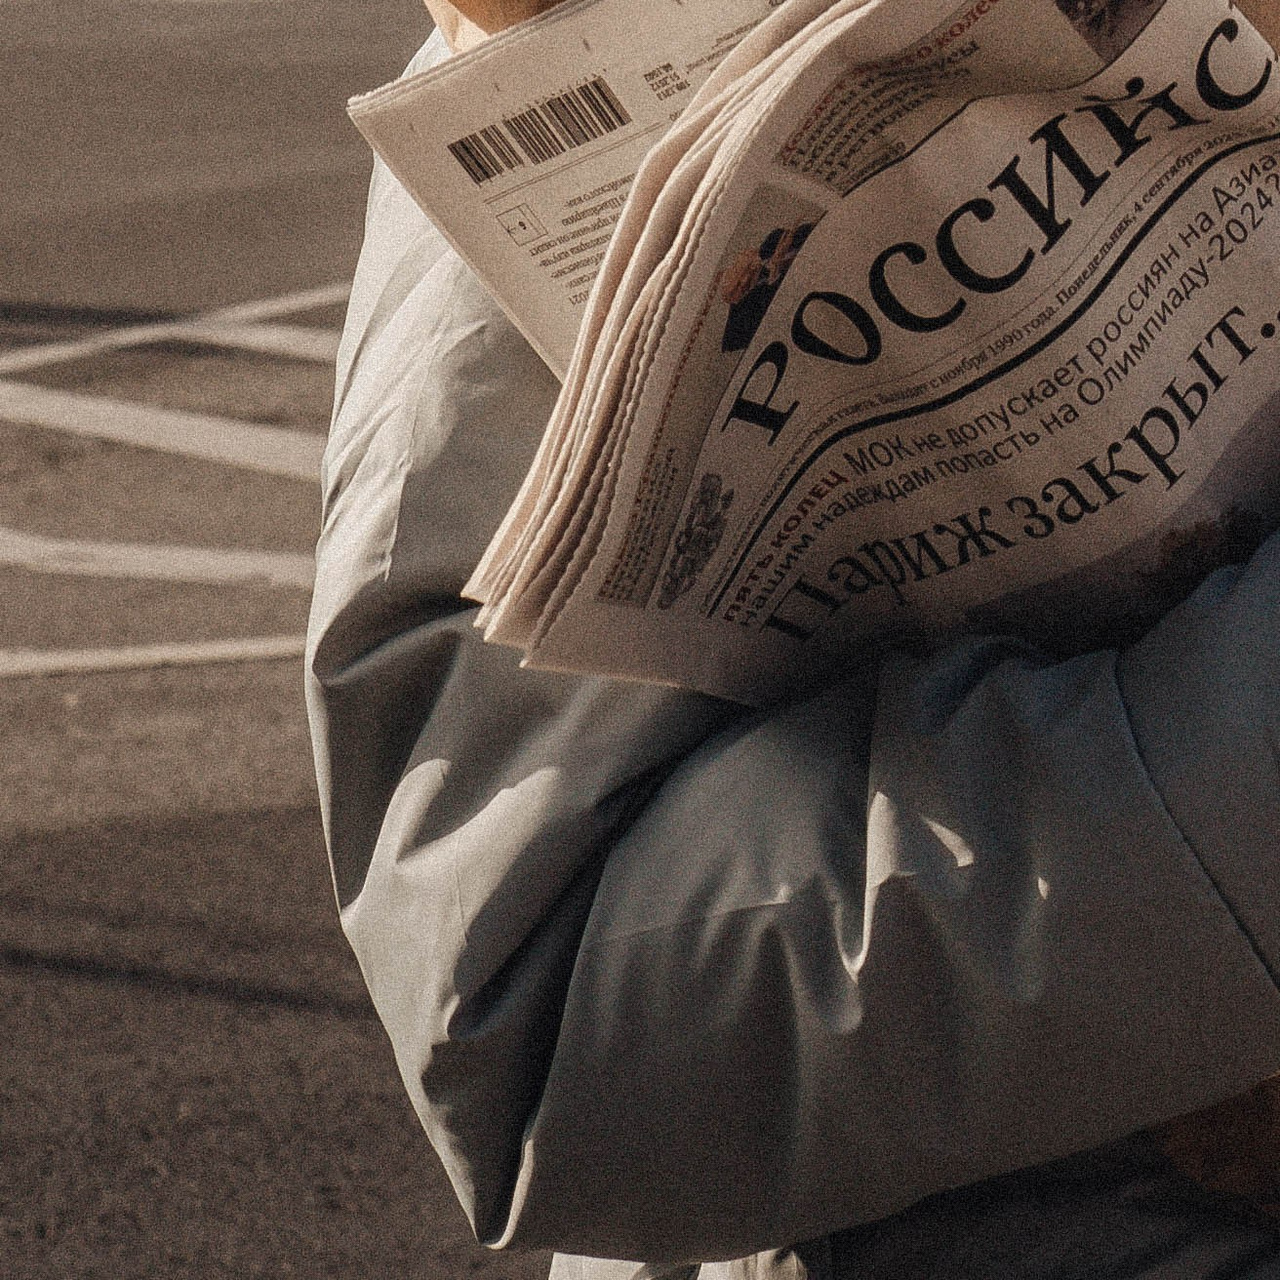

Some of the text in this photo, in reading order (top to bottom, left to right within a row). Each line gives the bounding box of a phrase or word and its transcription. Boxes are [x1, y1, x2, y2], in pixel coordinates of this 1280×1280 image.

[721, 17, 1279, 446] РОССИЙС
[938, 351, 988, 386] ноября
[988, 330, 1023, 358] 1990
[1021, 305, 1059, 338] года.
[1054, 212, 1138, 307] Понедельник,
[1133, 201, 1145, 215] 4
[1141, 148, 1201, 203] сентября
[770, 468, 850, 549] КОЛЕЦ
[842, 433, 915, 477] МОК
[911, 432, 947, 454] не
[946, 353, 1085, 450] допускает
[1085, 243, 1181, 367] россиян
[1178, 210, 1215, 249] на
[812, 465, 937, 532] надеждам
[935, 429, 1041, 479] попасть
[1039, 401, 1080, 436] на
[758, 505, 1017, 640] Париж
